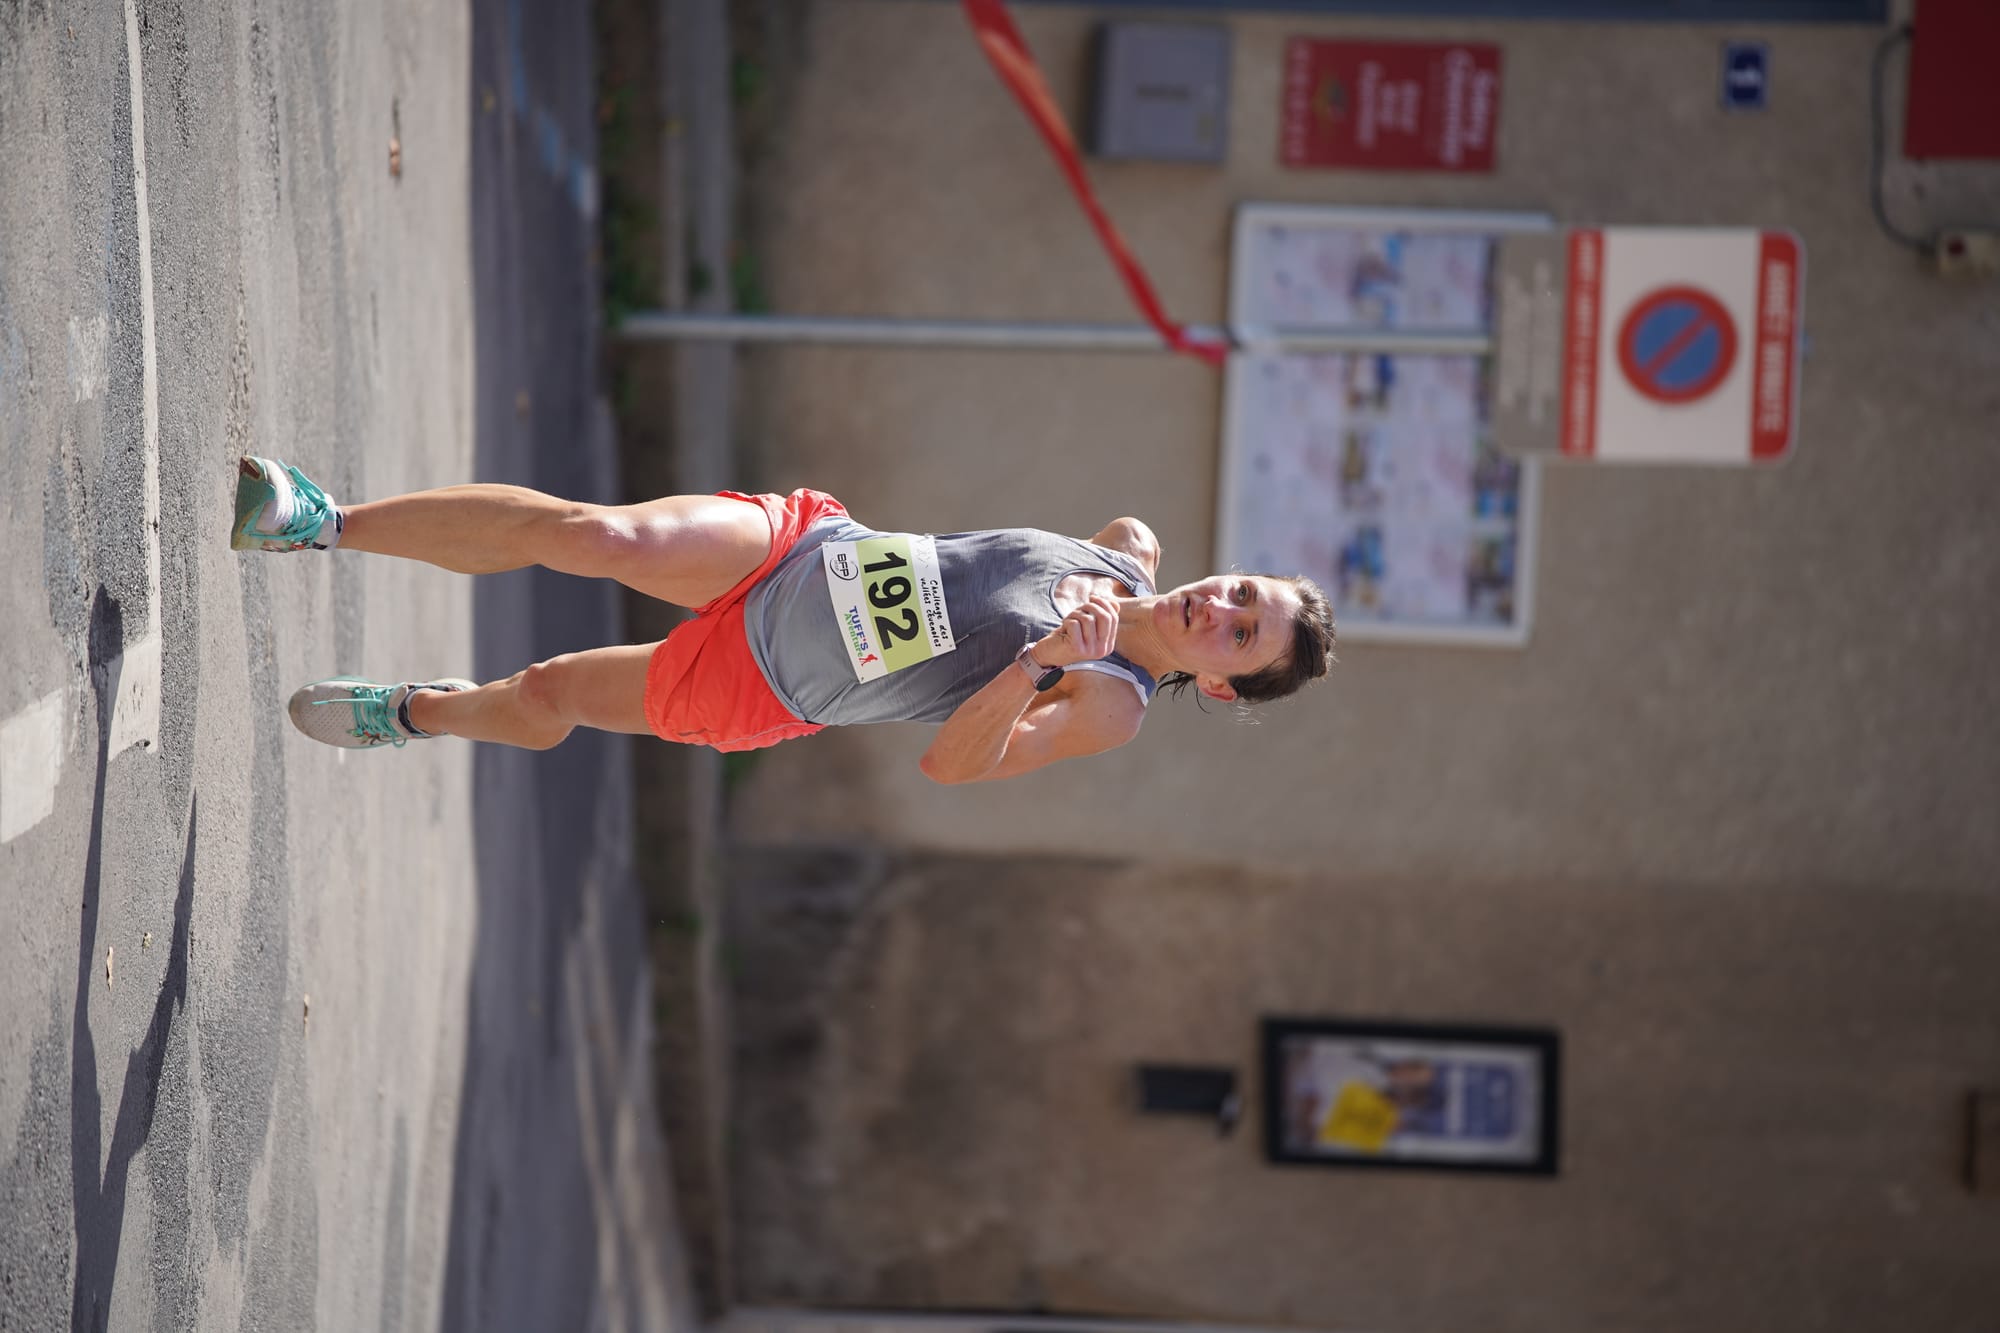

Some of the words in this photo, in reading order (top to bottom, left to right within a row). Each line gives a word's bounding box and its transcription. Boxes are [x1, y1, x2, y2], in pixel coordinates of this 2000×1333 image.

[837, 553, 850, 577] BFP
[863, 552, 919, 650] 192
[930, 579, 943, 620] Challenge
[939, 624, 949, 640] des
[844, 613, 863, 658] Aventure
[849, 605, 869, 651] TUFF'S
